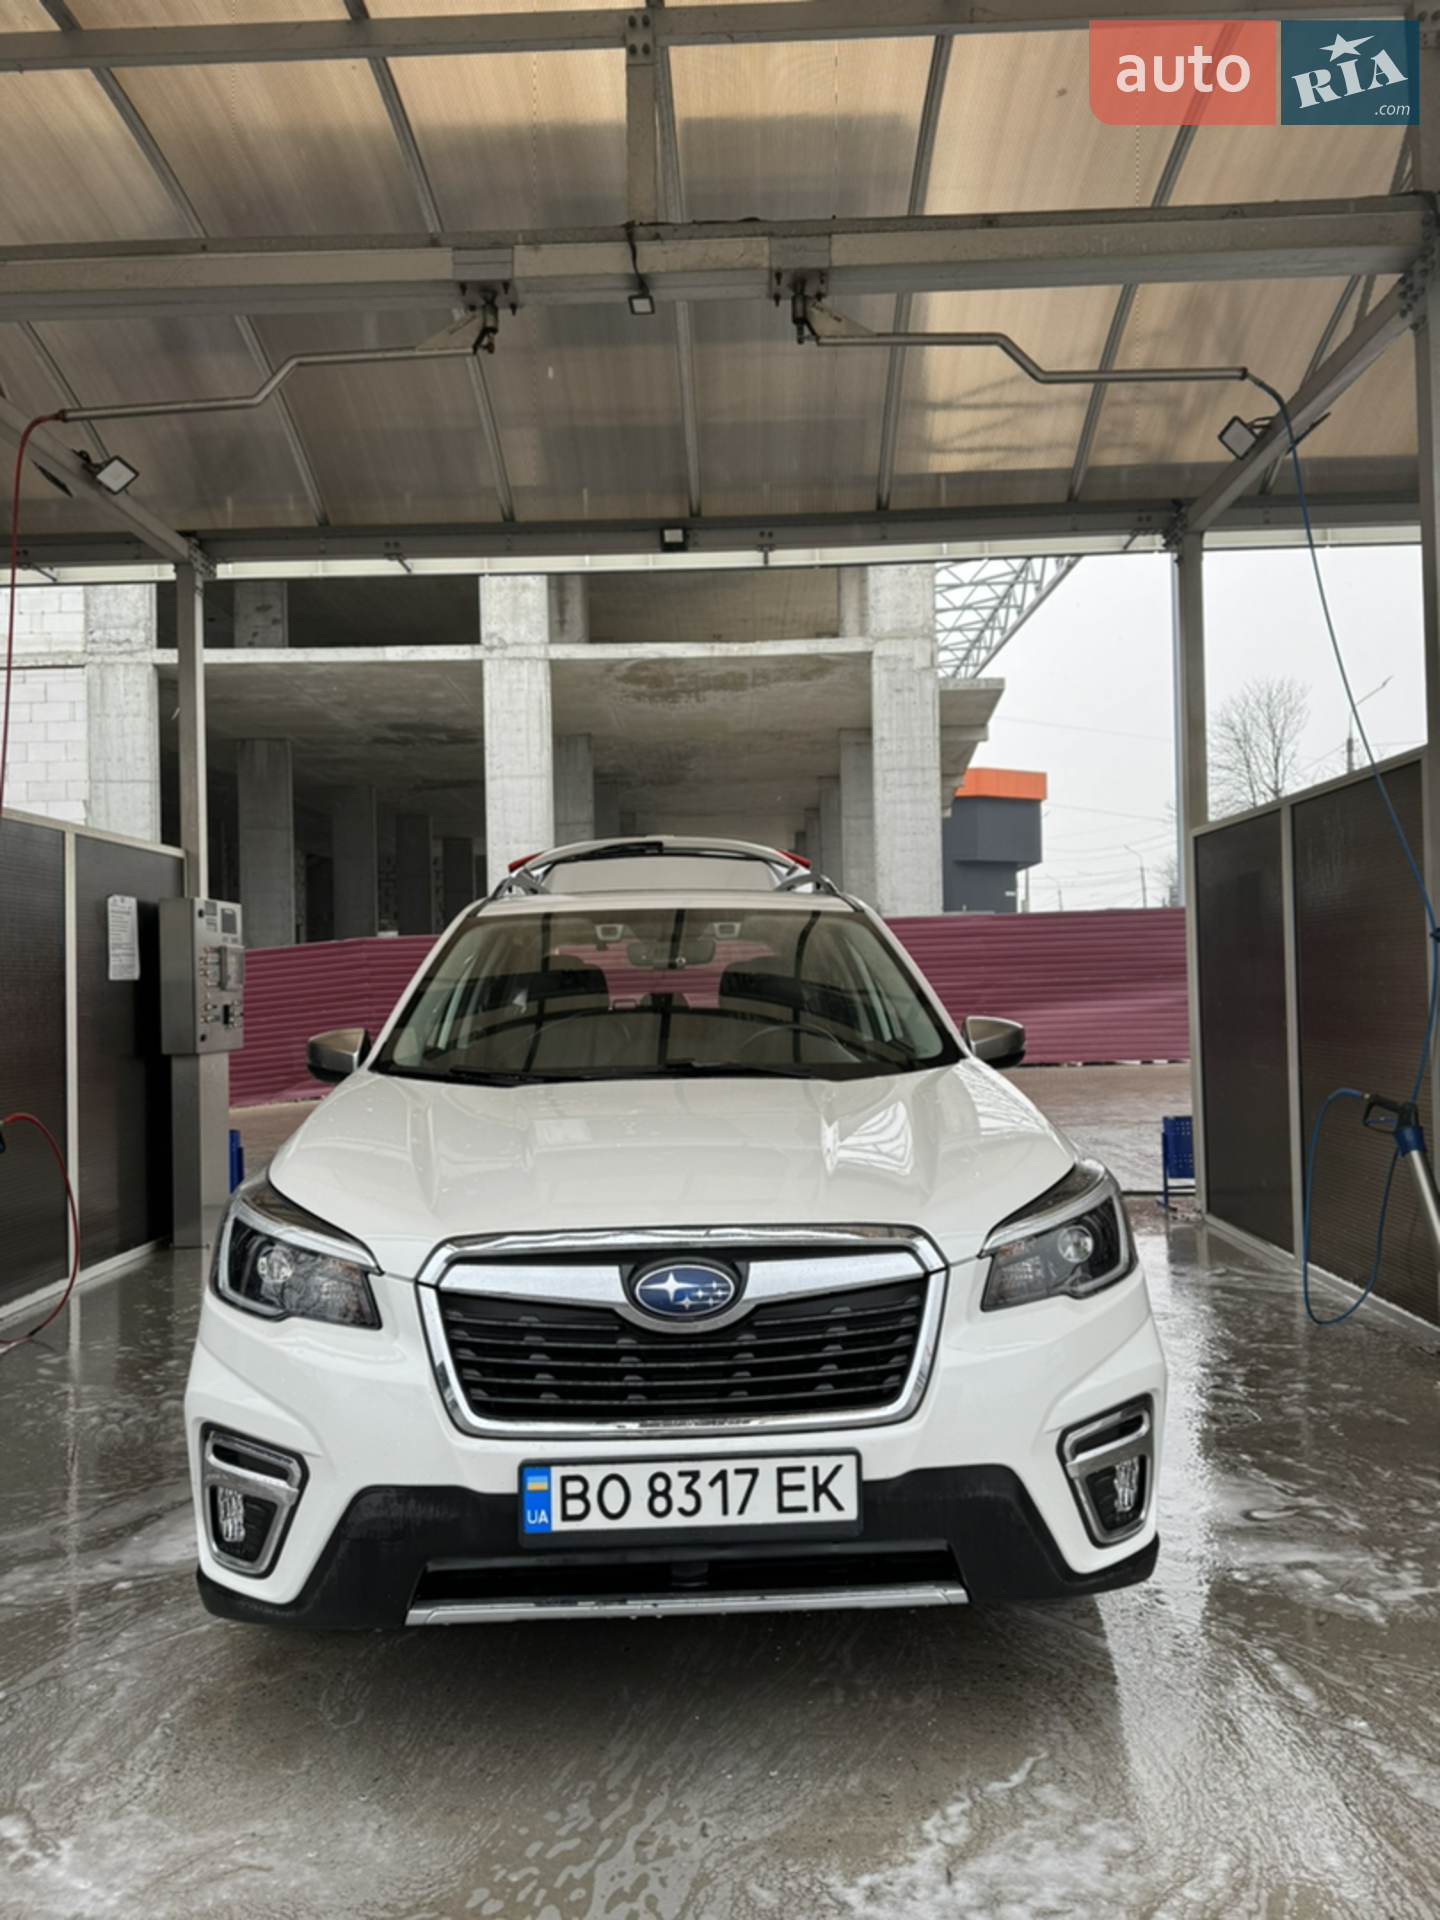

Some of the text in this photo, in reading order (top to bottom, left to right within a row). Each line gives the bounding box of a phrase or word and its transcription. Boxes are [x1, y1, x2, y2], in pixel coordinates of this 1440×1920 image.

[560, 1464, 845, 1522] BO 8317 EK
[527, 1510, 549, 1525] UA
